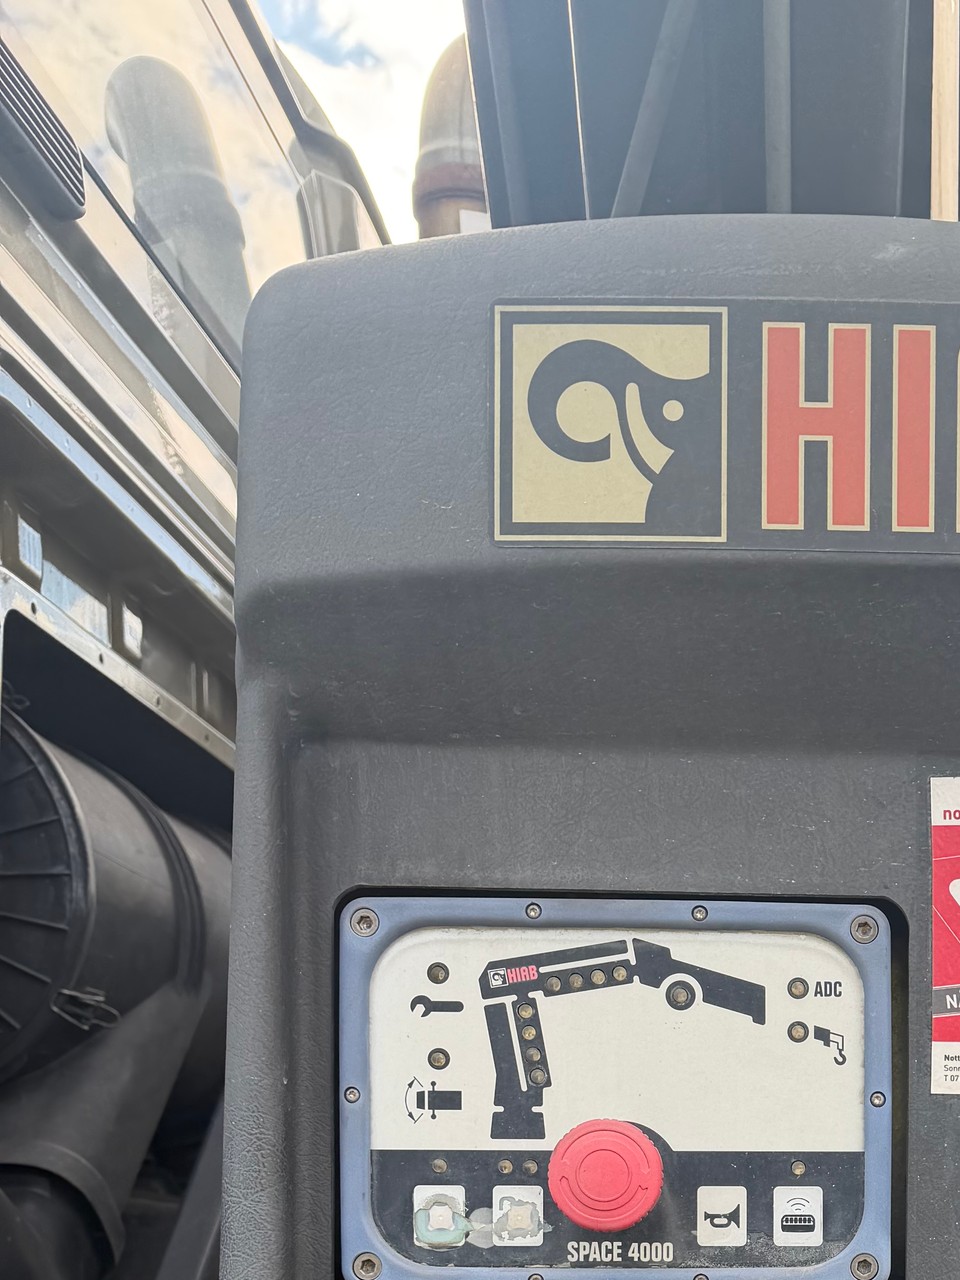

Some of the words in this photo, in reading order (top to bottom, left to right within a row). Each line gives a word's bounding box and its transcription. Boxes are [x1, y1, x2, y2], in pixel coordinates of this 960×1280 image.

[507, 965, 538, 984] HIAB
[813, 981, 842, 998] ADC
[567, 1240, 623, 1262] SPACE
[627, 1241, 674, 1262] 4000
